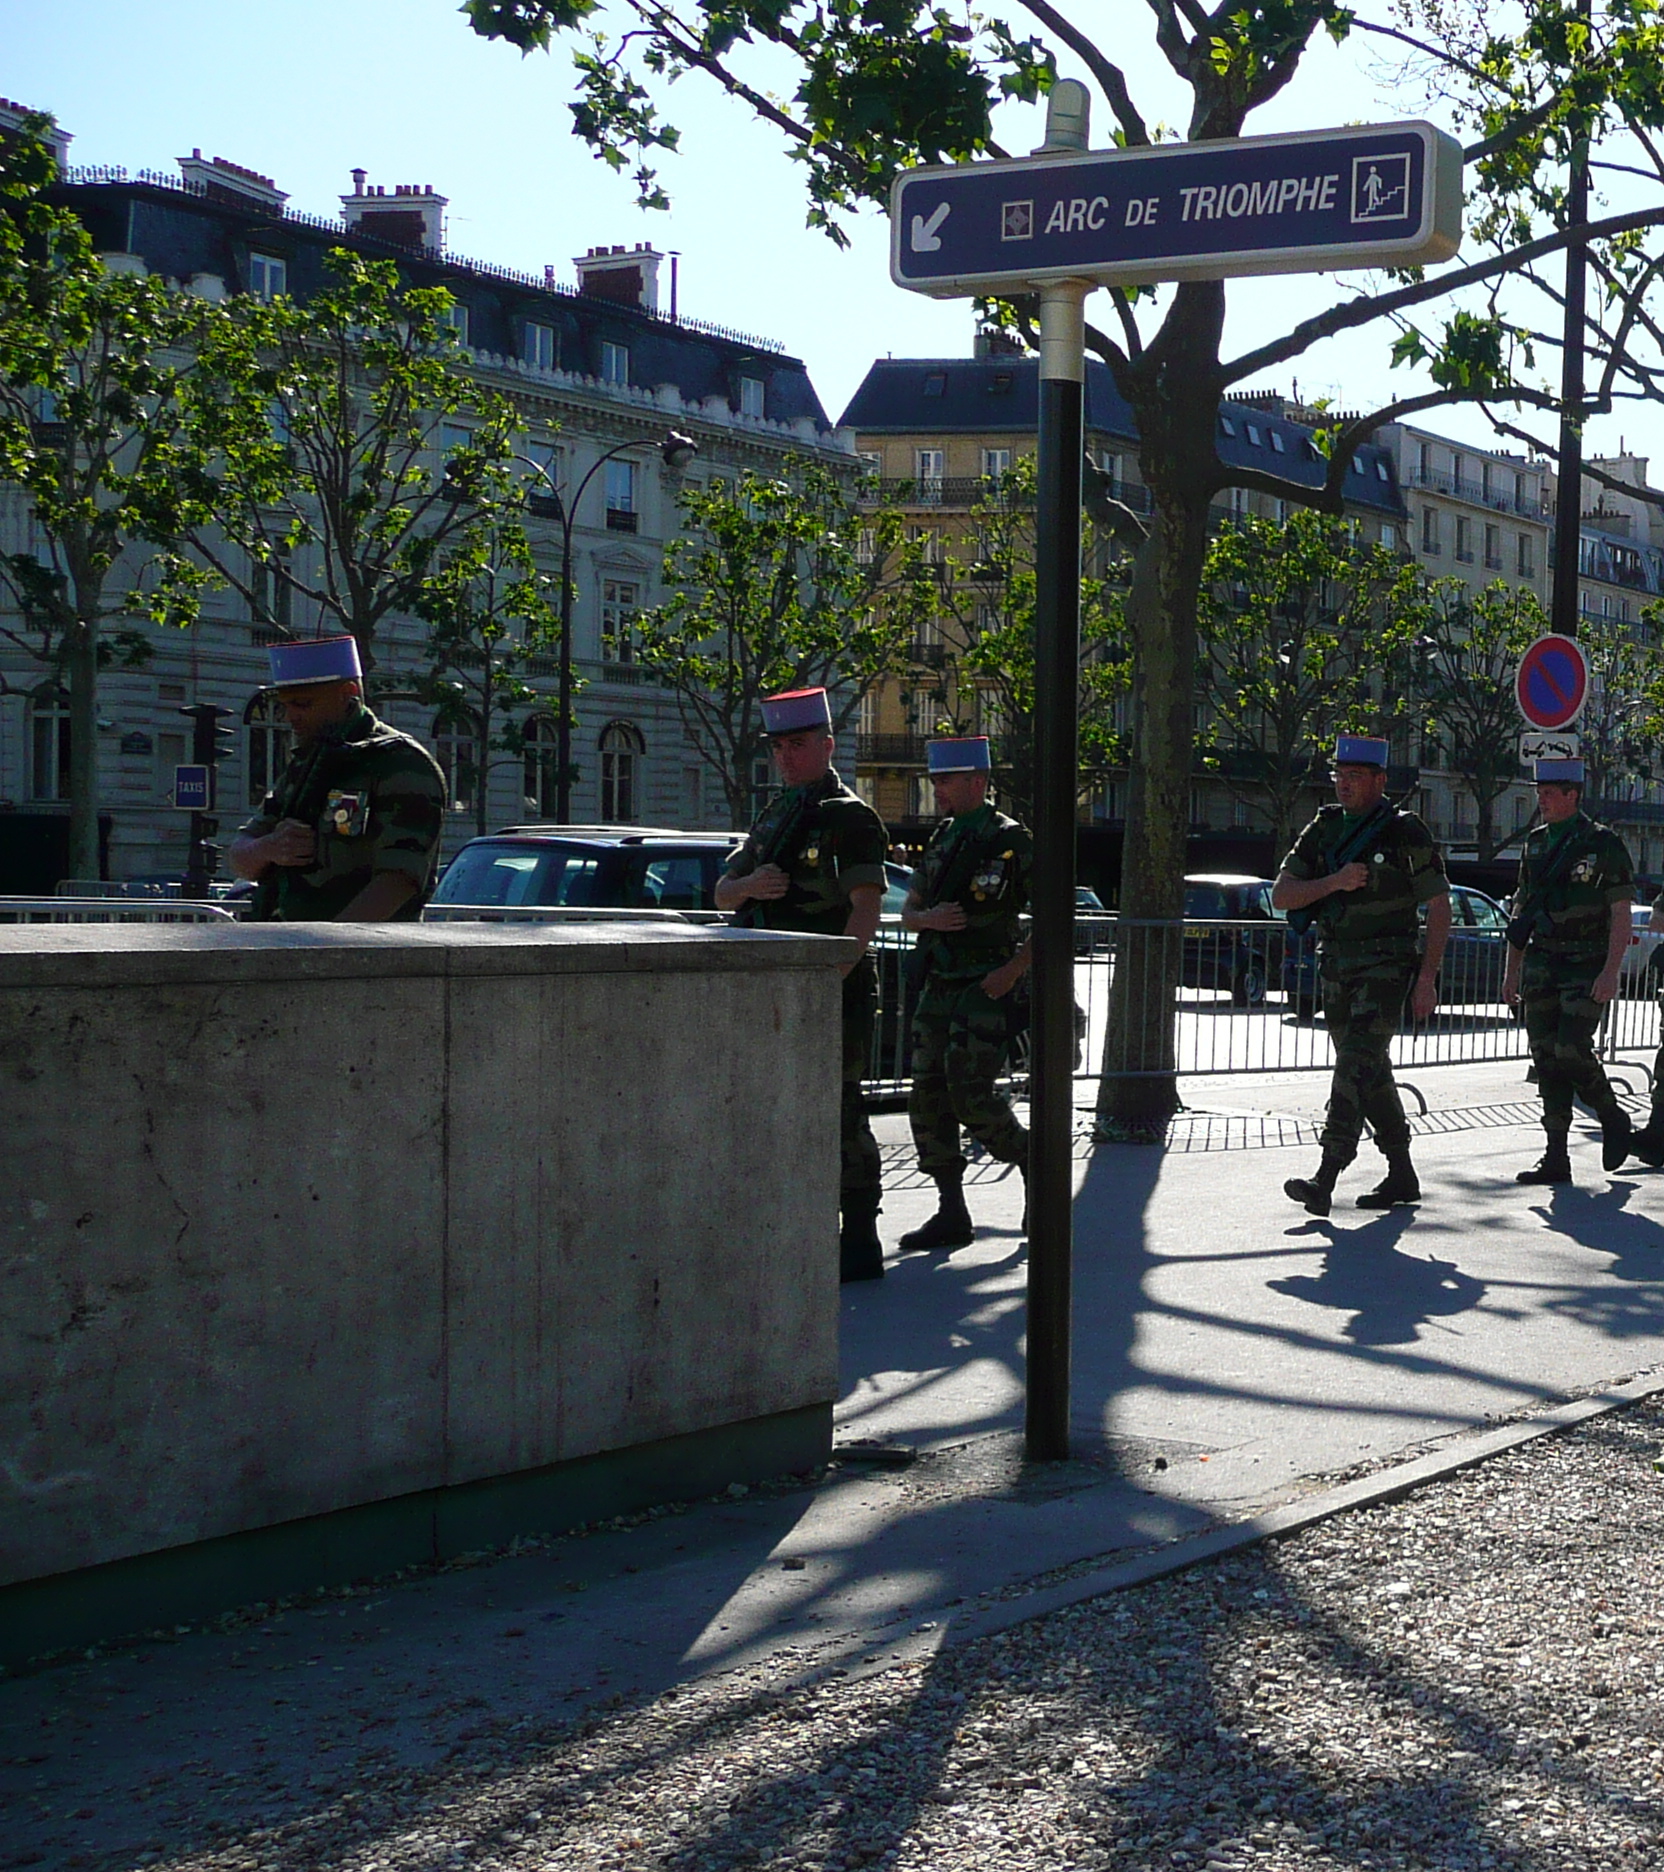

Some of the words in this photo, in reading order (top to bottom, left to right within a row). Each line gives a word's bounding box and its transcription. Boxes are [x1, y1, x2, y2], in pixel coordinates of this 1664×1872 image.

[1044, 196, 1109, 234] ARC
[1125, 197, 1159, 227] DE
[1178, 174, 1340, 222] TRIOMPHE
[178, 781, 204, 793] TAXIS
